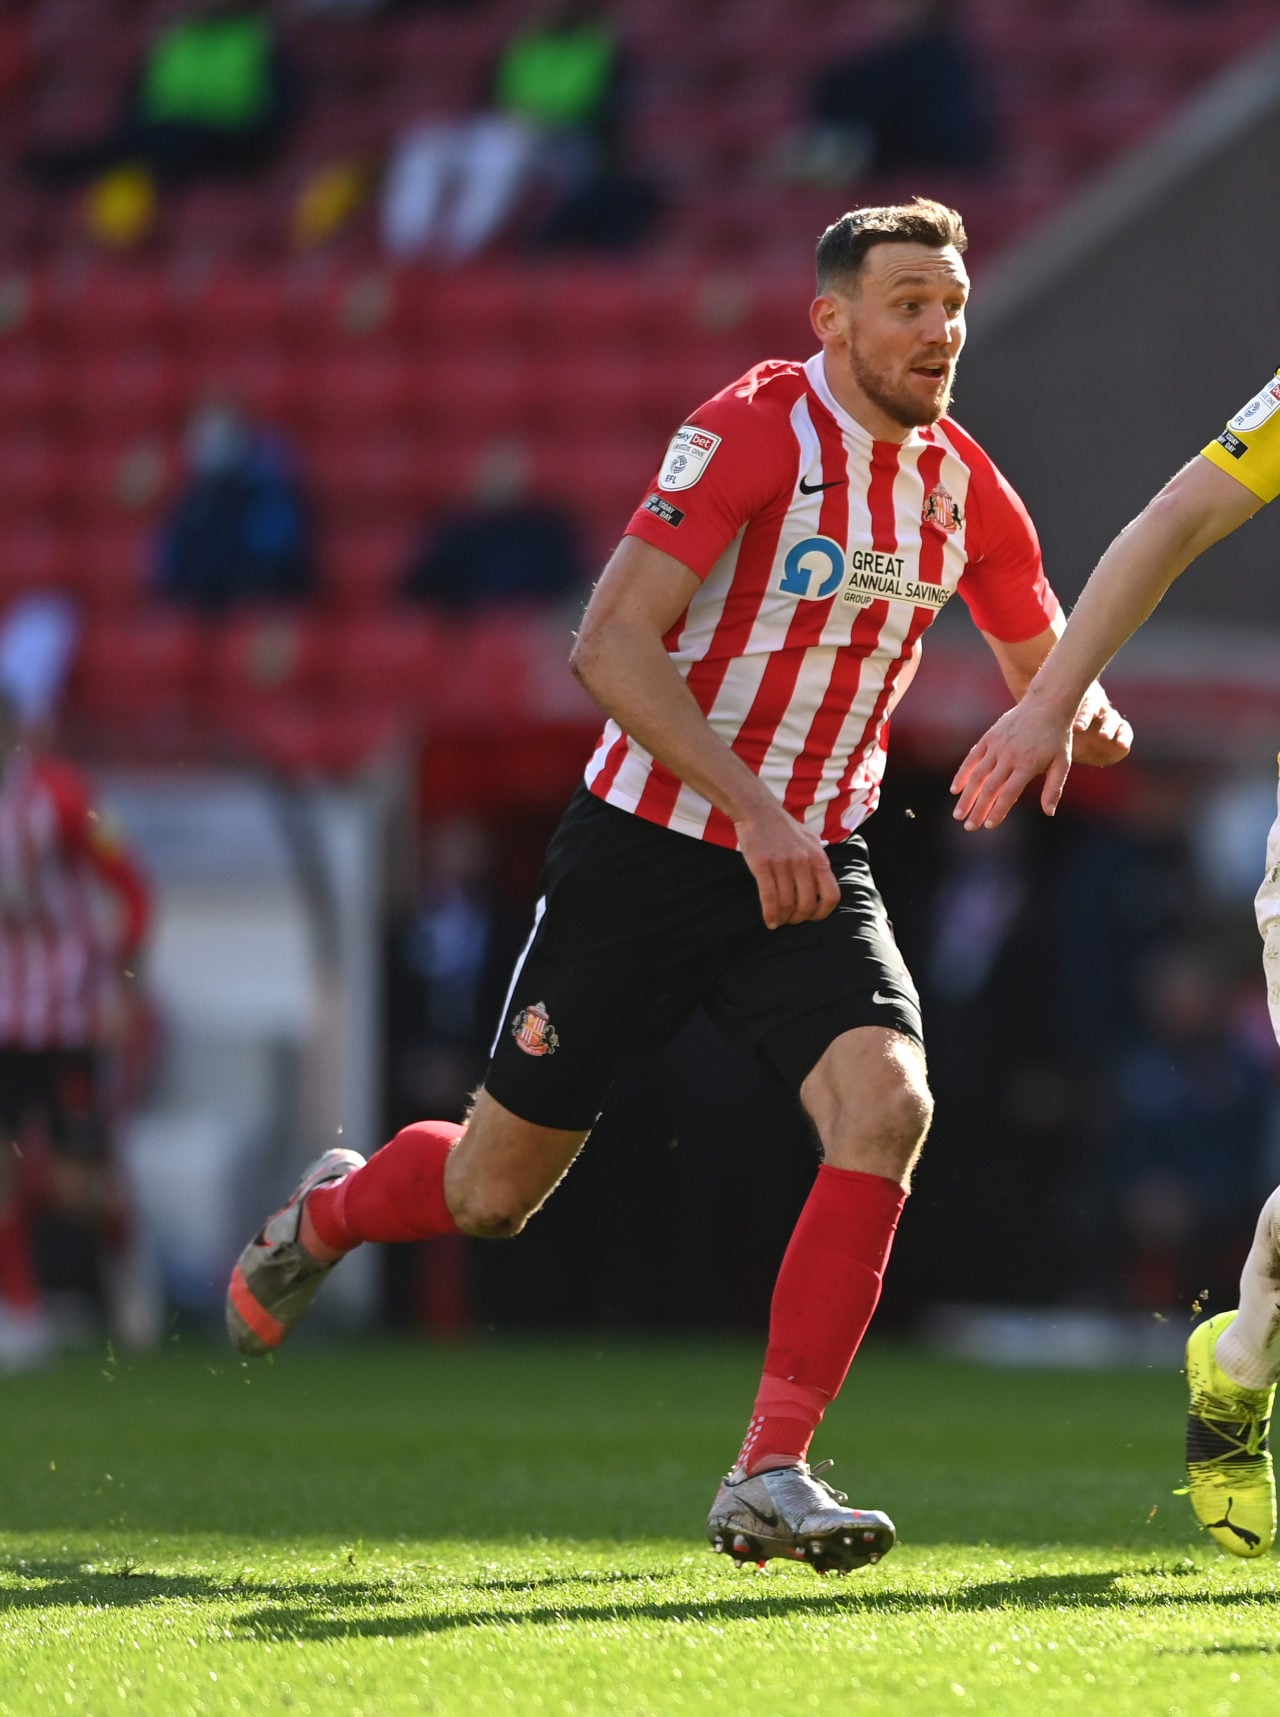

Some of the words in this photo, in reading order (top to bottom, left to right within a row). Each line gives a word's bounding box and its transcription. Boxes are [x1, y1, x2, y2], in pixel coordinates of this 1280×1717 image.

[692, 434, 712, 449] bet
[692, 448, 706, 459] ONE
[665, 474, 677, 485] EFL
[660, 510, 673, 521] DAY
[852, 550, 904, 578] GREAT
[848, 572, 902, 596] ANNUAL
[843, 592, 872, 605] GROUP
